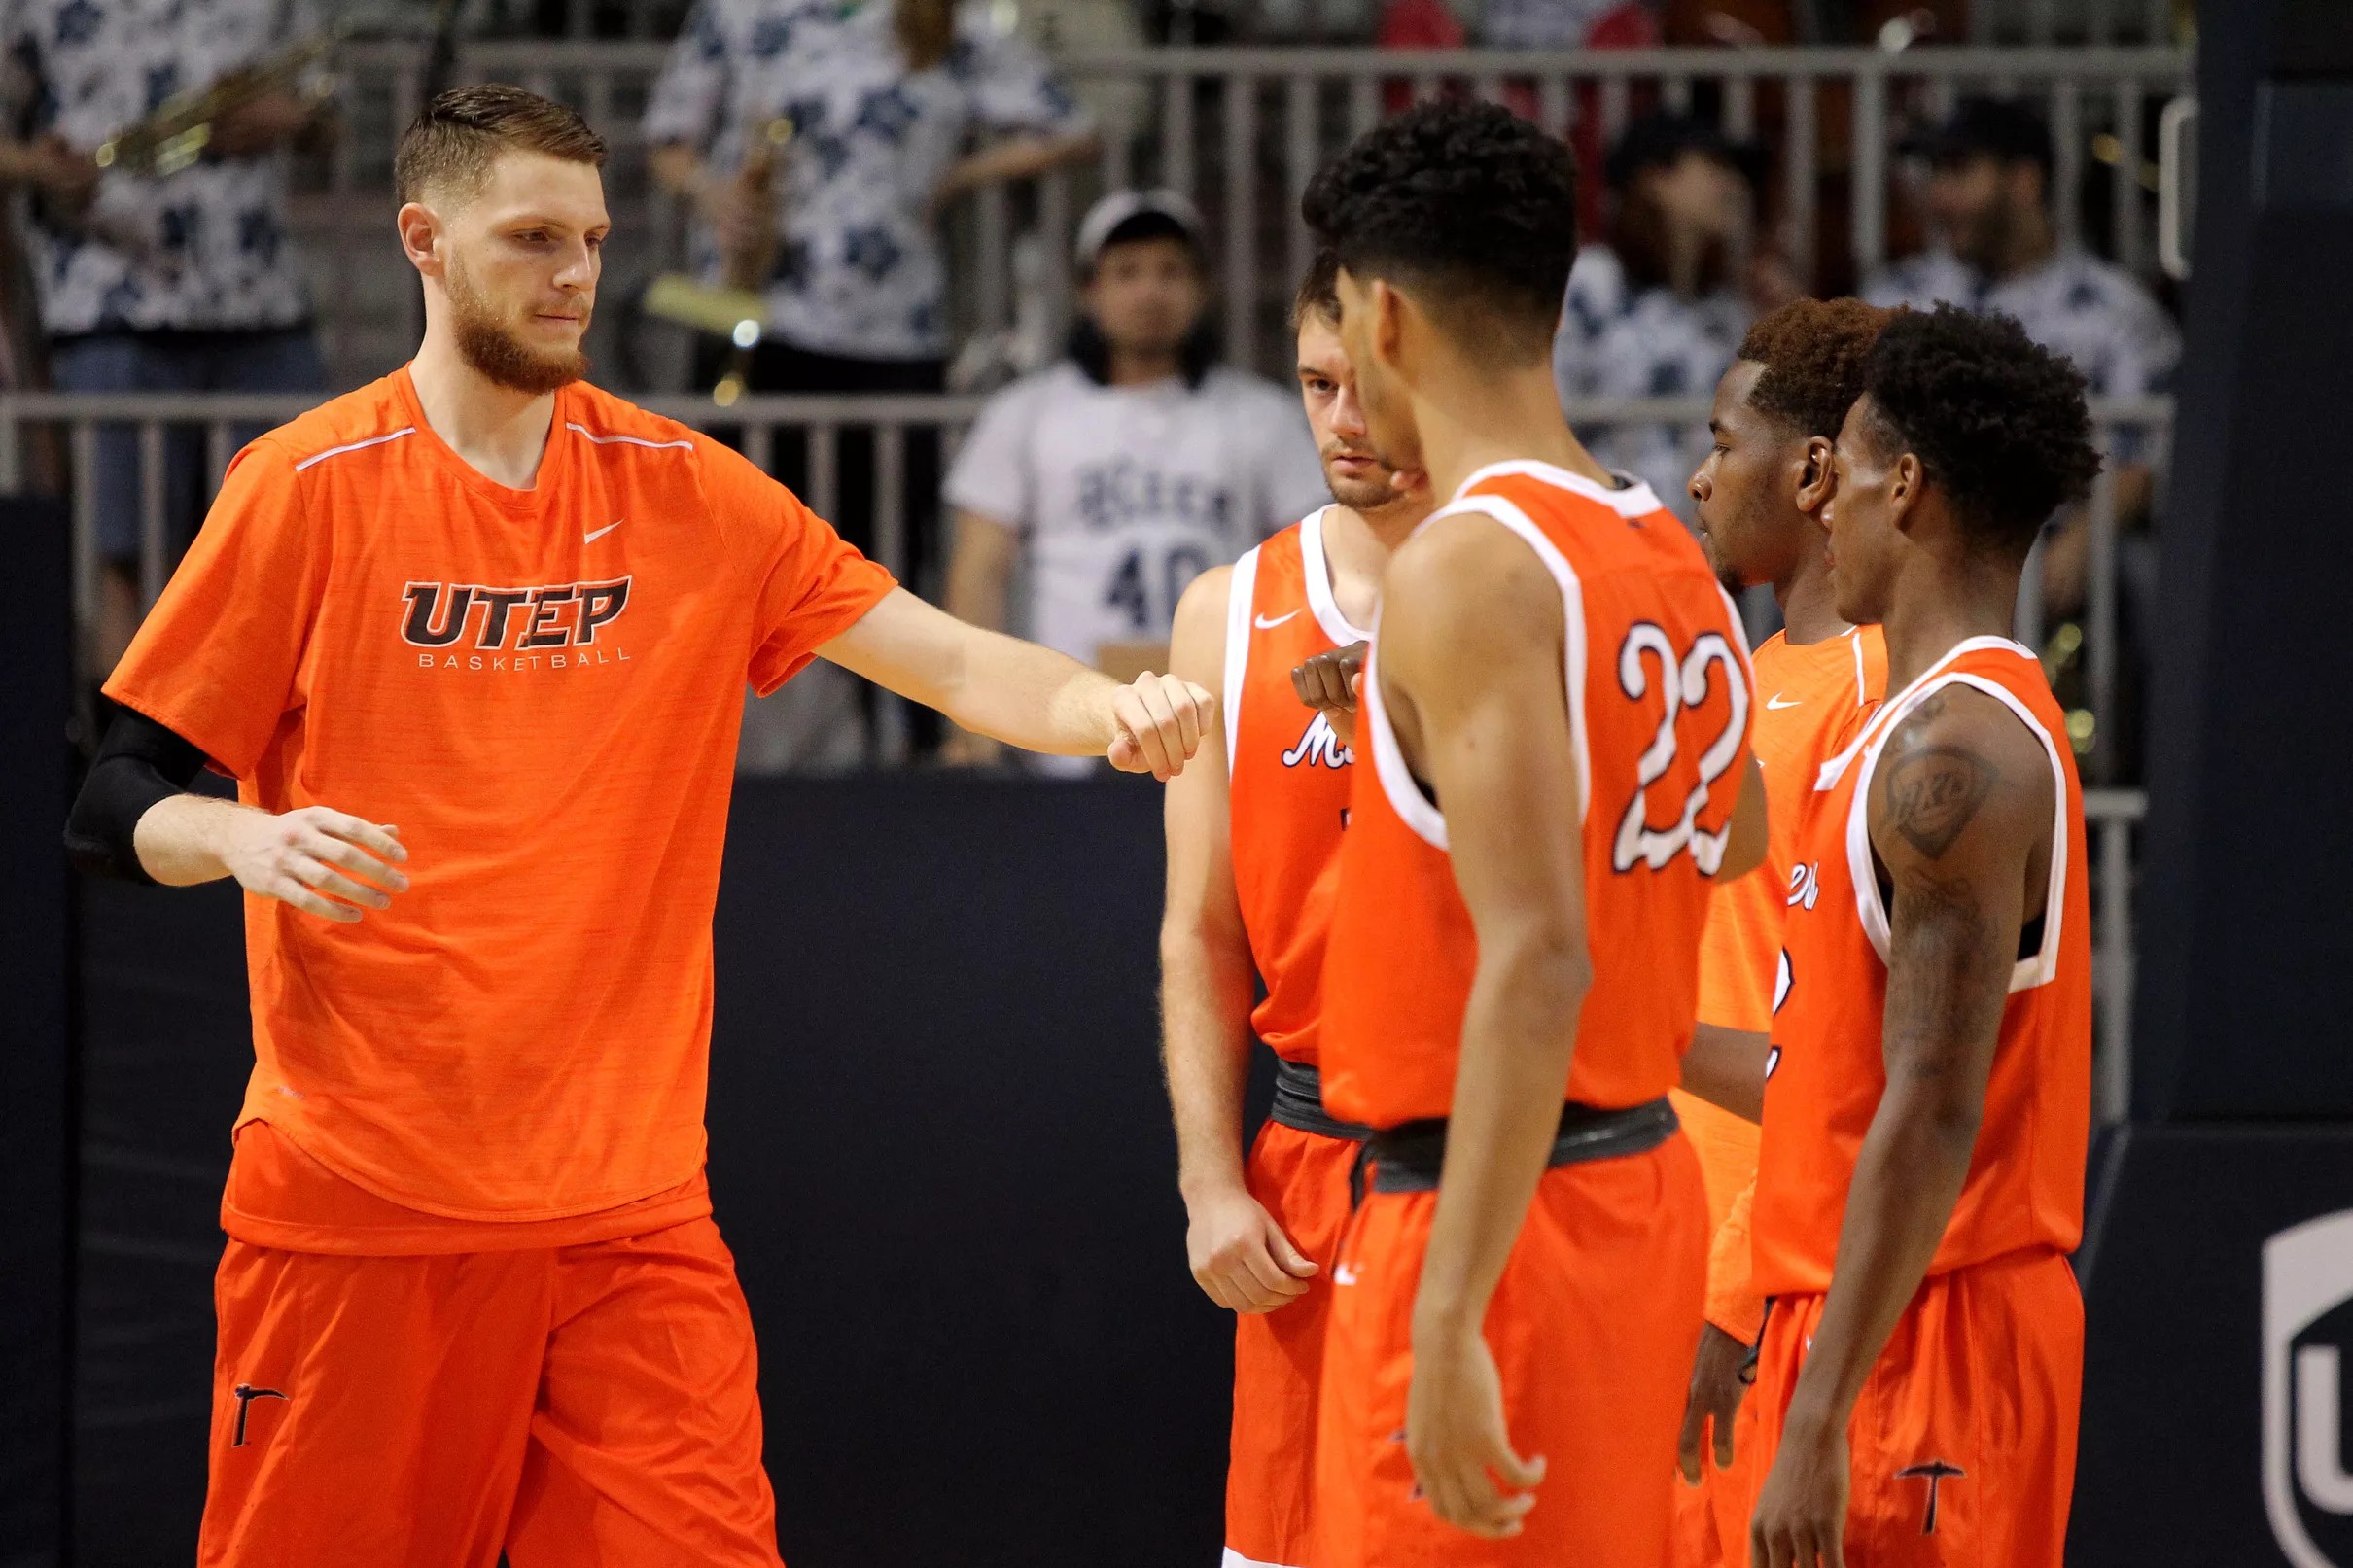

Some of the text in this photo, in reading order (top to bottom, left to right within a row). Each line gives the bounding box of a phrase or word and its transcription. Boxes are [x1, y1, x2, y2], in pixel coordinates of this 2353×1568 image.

[401, 575, 632, 650] UTEP
[418, 647, 630, 671] BASKETBALL
[1613, 620, 1749, 876] 22
